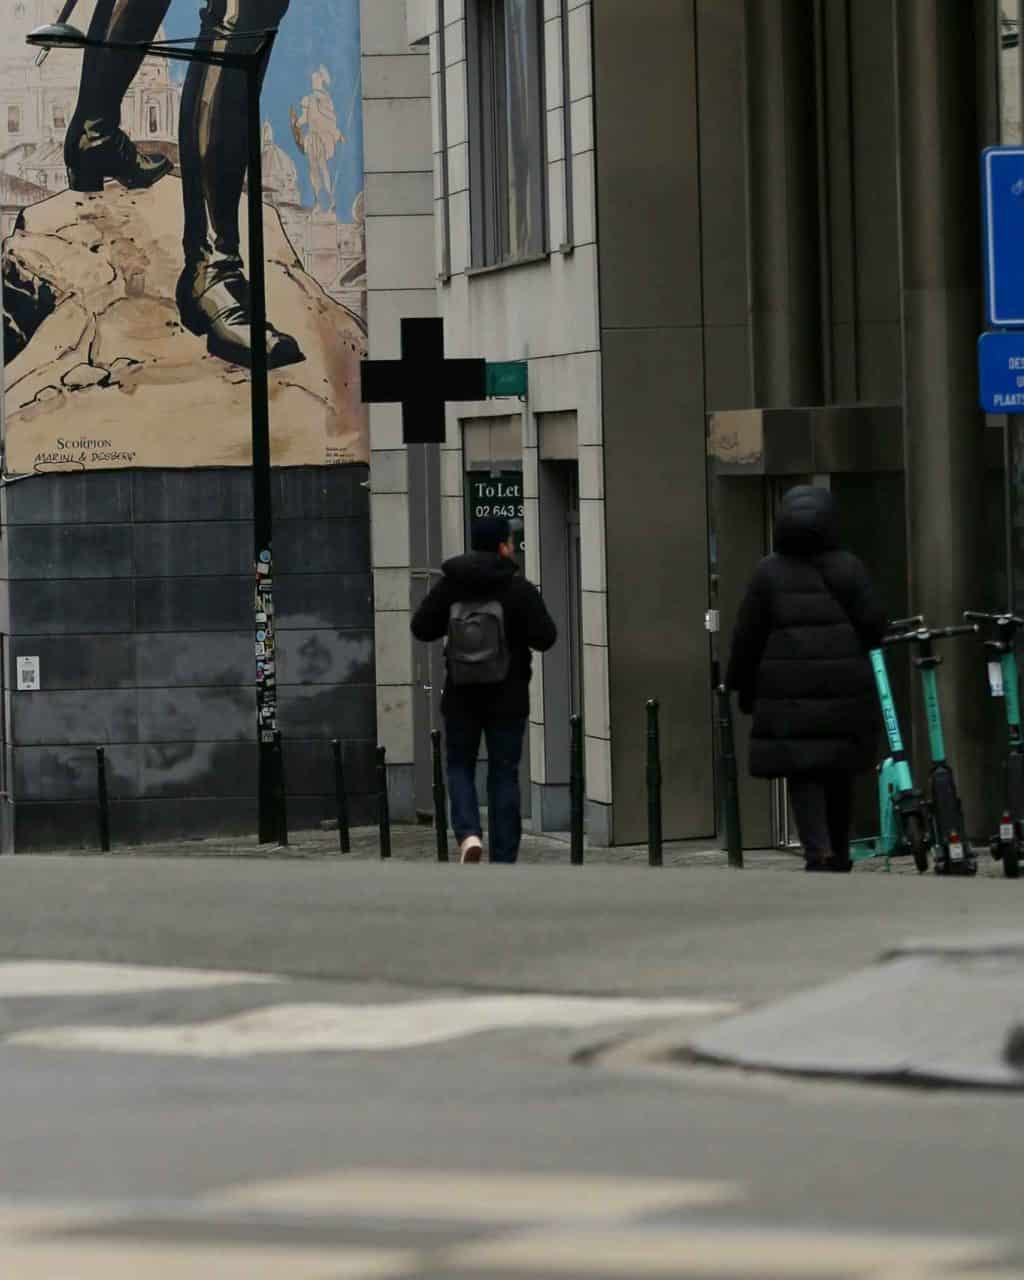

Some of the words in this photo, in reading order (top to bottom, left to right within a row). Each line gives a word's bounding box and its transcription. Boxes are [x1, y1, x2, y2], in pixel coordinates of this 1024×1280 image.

[475, 482, 495, 497] To
[497, 482, 521, 497] Let
[476, 505, 490, 518] 02
[493, 504, 515, 518] 643
